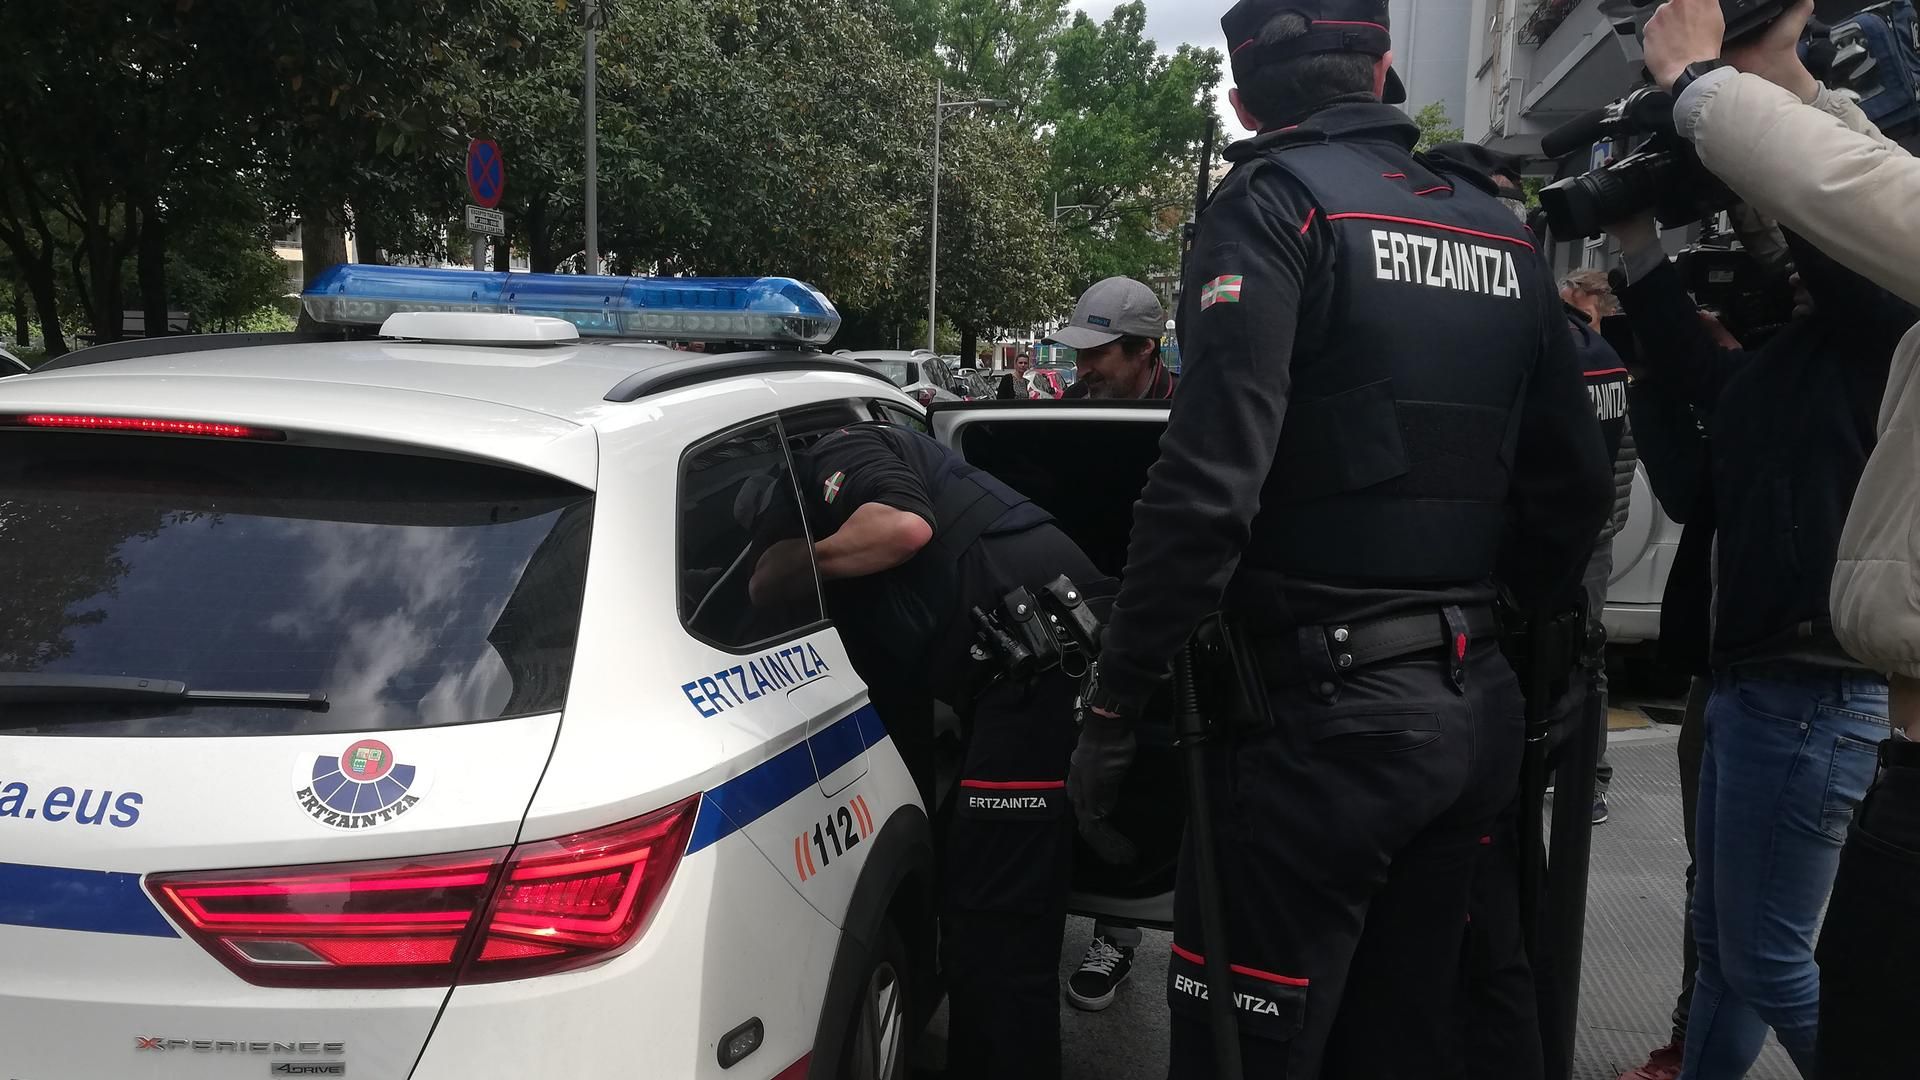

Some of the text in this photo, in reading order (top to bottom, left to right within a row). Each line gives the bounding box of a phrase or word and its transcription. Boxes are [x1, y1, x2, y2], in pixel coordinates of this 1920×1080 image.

[1372, 229, 1521, 299] ERTZAINTZA
[681, 642, 830, 718] ERTZAINTZA
[0, 780, 143, 828] a.eus
[296, 786, 420, 829] ERTZAINTZA
[969, 796, 1047, 809] ERTZAINTZA
[1174, 974, 1280, 1017] ERTZNTZA
[136, 1035, 345, 1054] XPERIENCE
[277, 1063, 341, 1074] 4DRIVE
